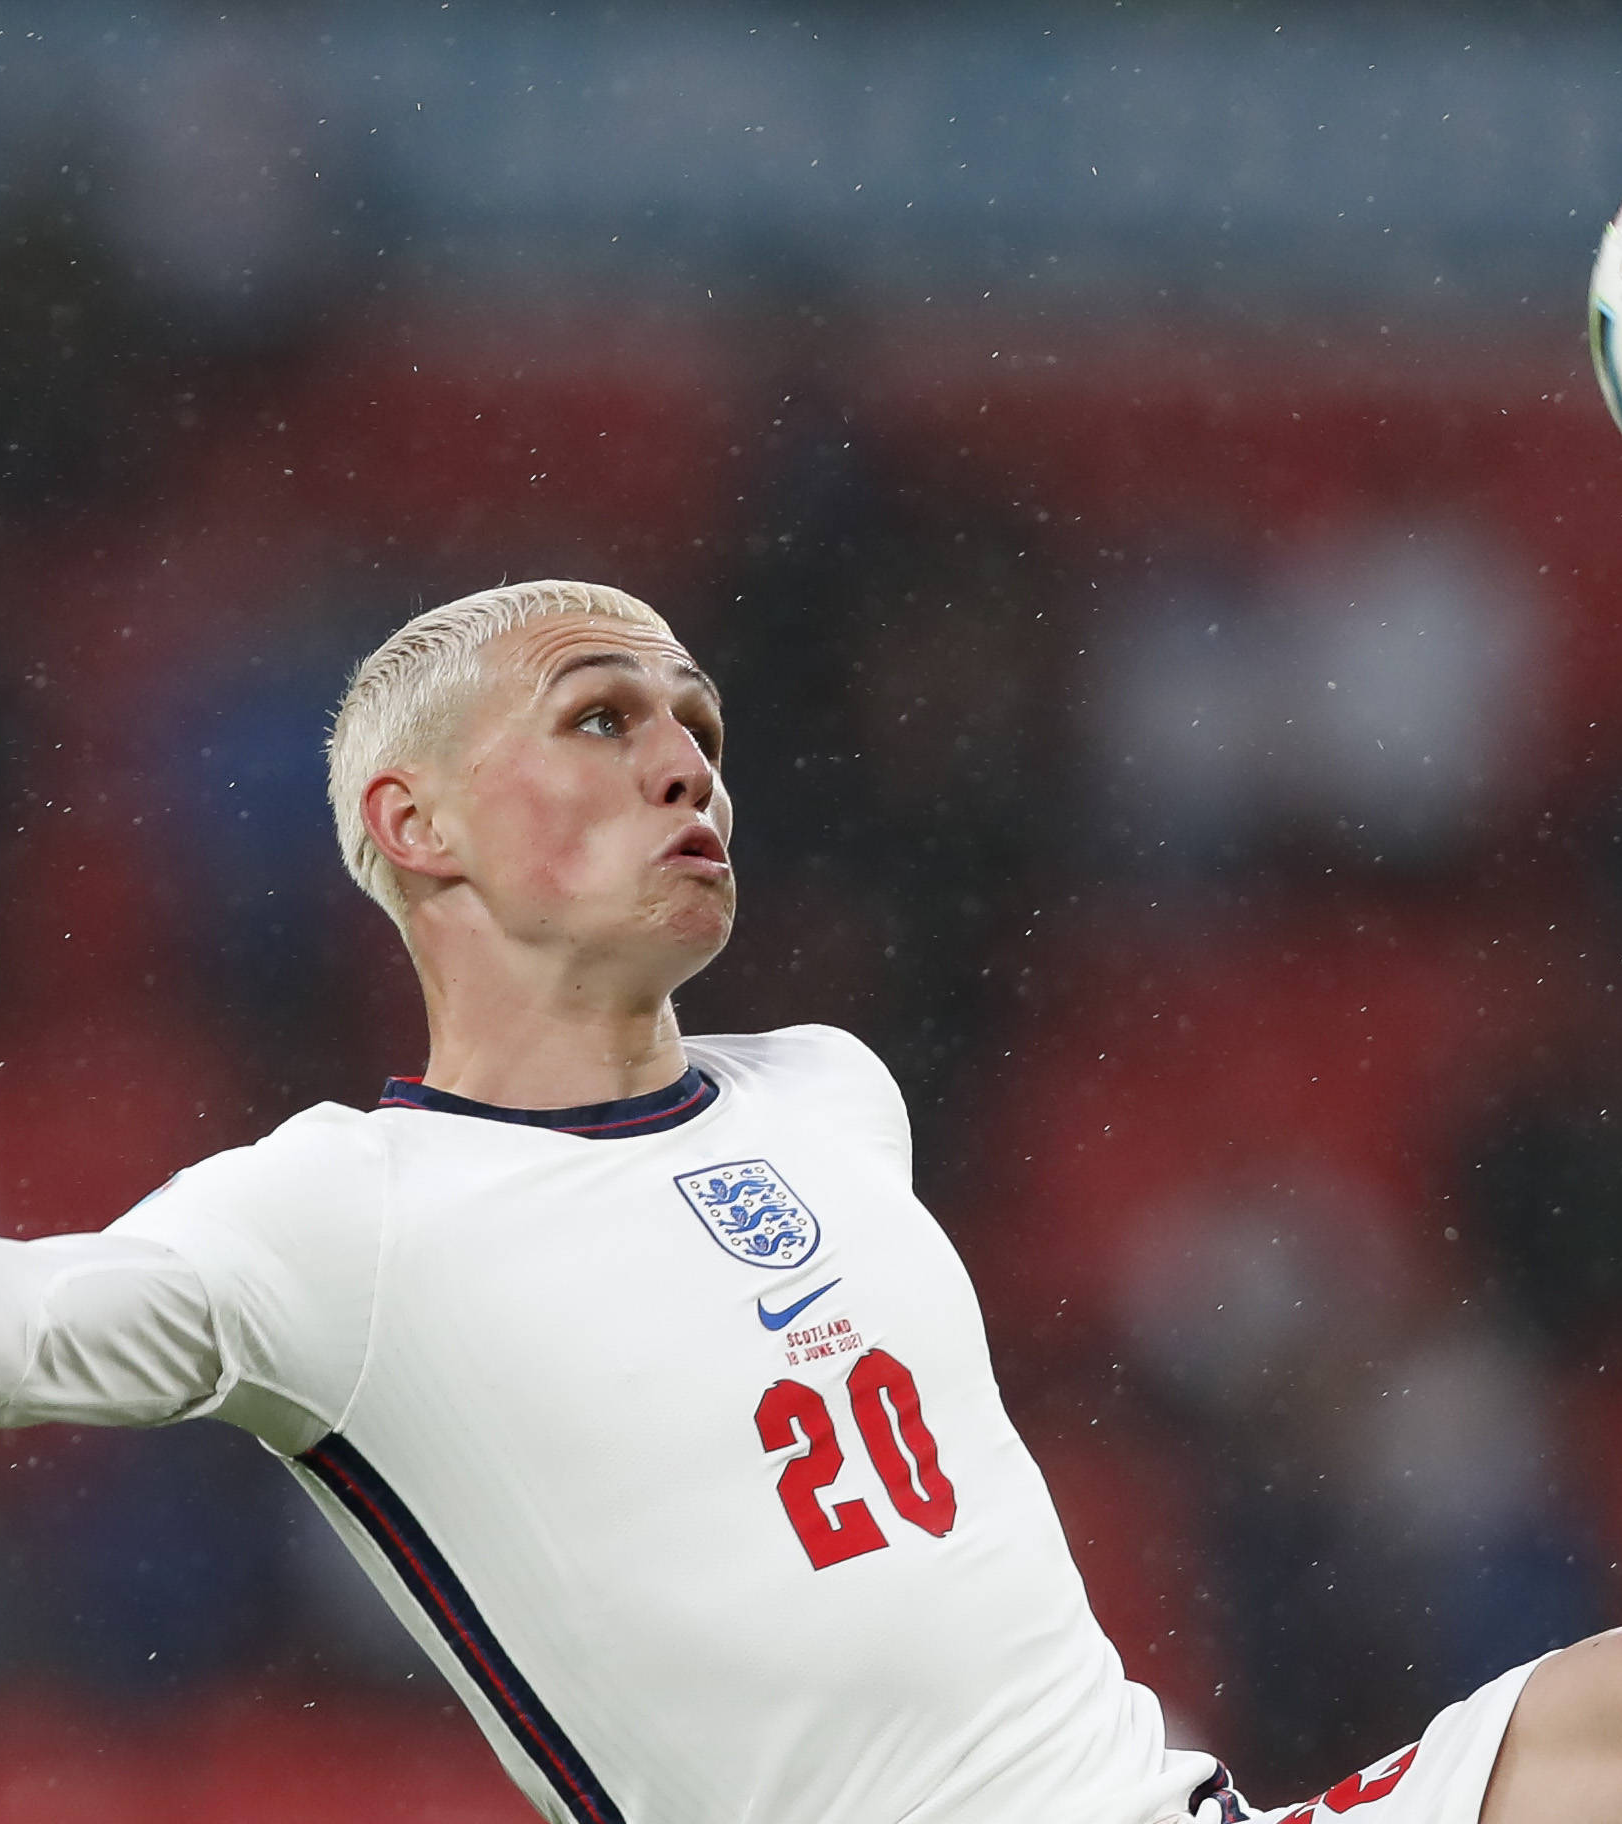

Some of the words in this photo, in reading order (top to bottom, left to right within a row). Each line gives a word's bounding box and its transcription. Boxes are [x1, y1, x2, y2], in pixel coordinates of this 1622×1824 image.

[786, 1319, 852, 1348] SCOTLAND
[804, 1342, 836, 1362] JUNE
[836, 1331, 864, 1353] 2021
[754, 1348, 957, 1571] 20
